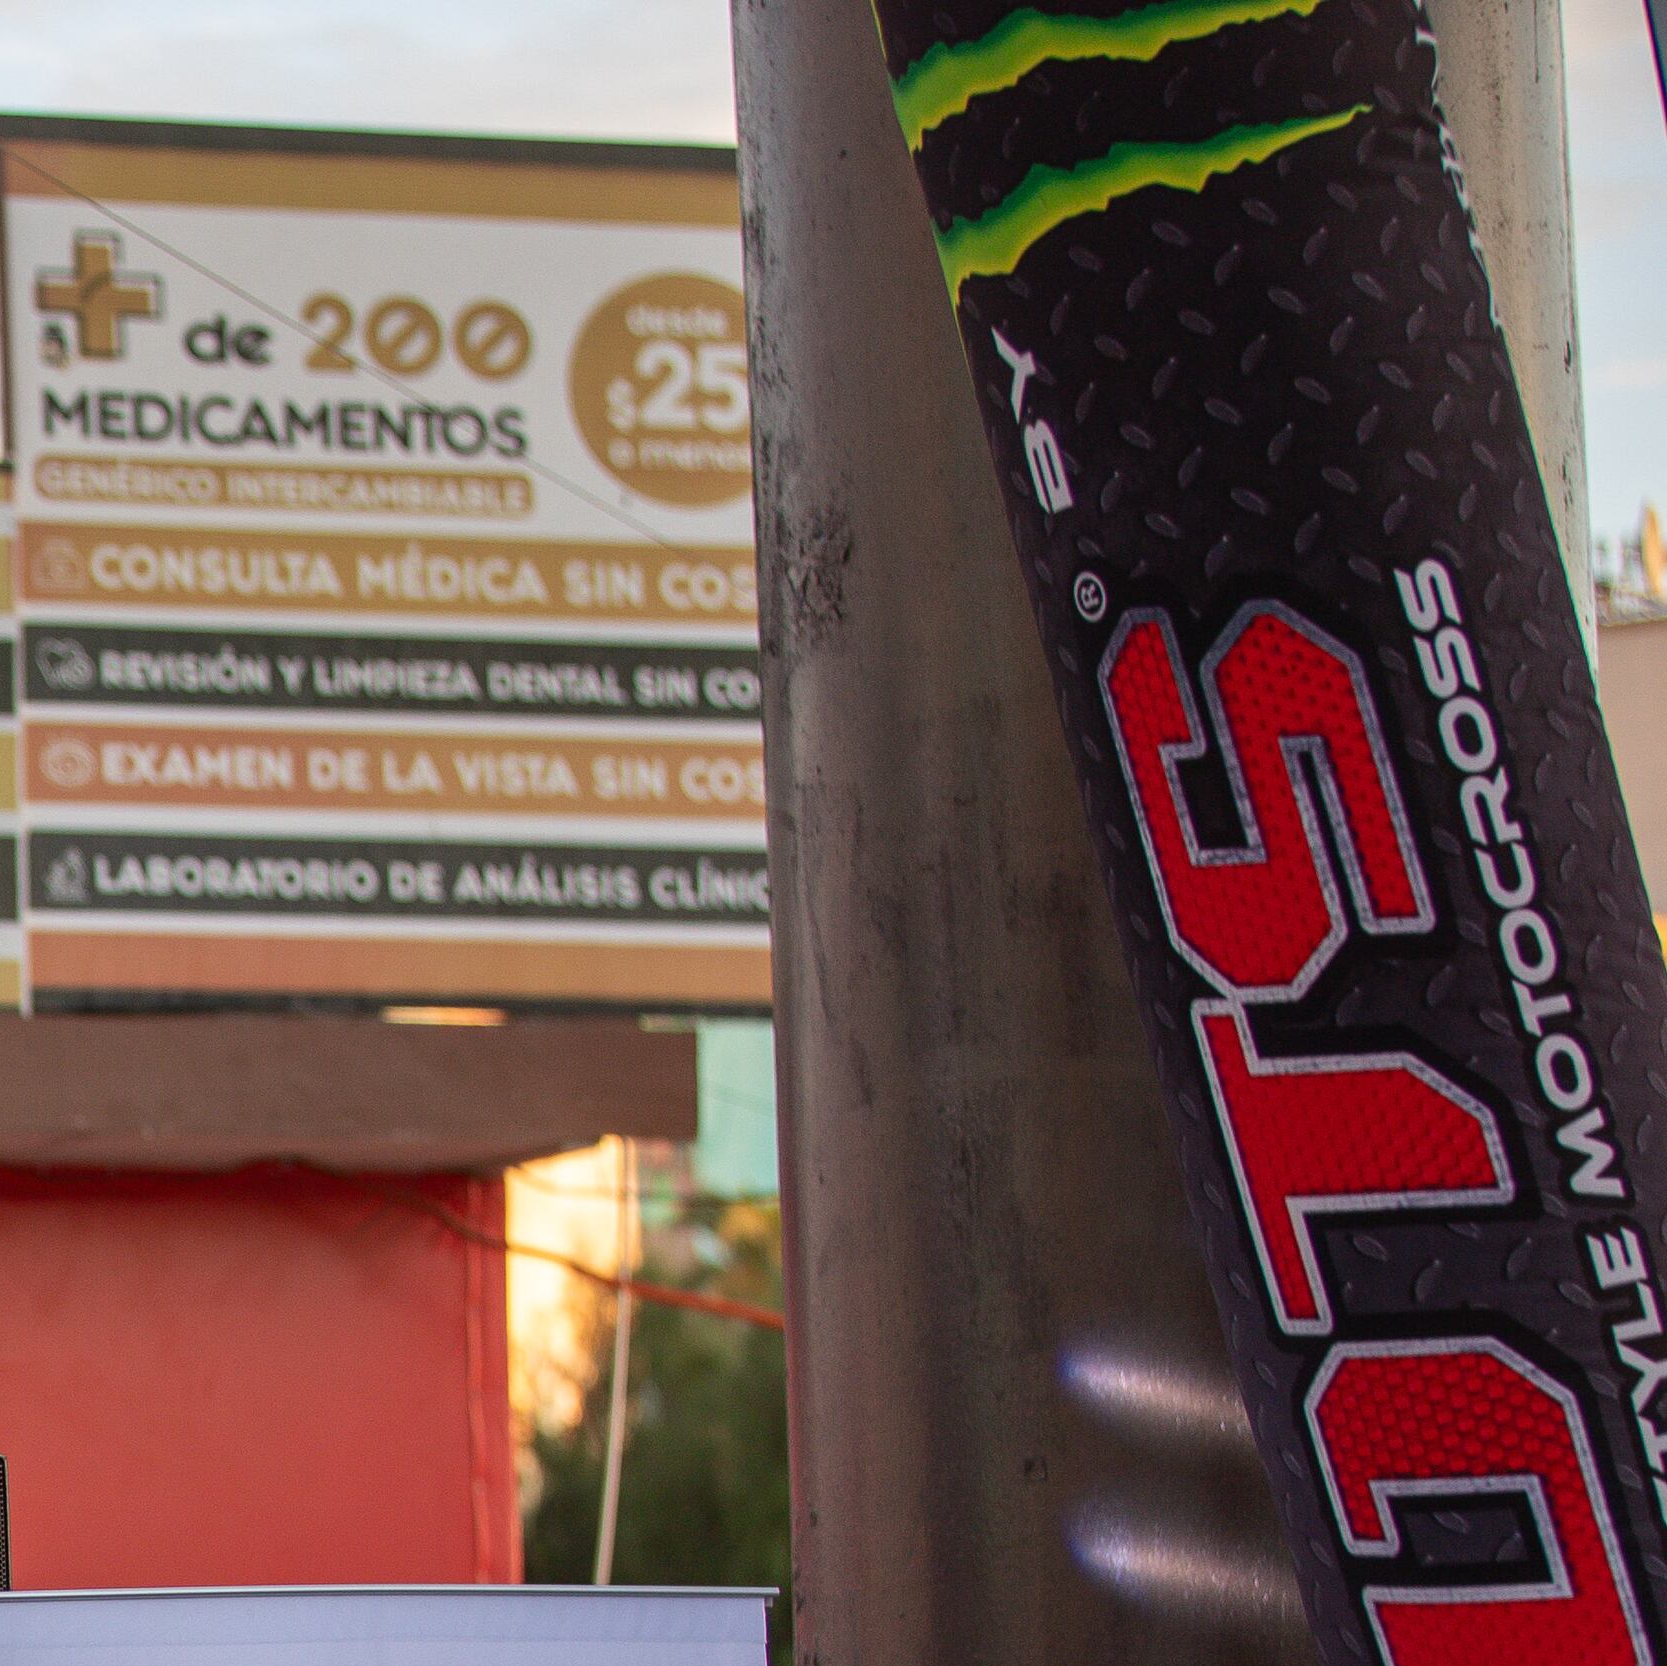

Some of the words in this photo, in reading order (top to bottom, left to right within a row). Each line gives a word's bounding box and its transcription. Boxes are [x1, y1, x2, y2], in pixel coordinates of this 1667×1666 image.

[184, 315, 275, 367] de
[41, 389, 528, 457] MEDICAMENTOS
[991, 327, 1073, 514] BY
[89, 544, 342, 598] CONSULTA
[358, 542, 548, 601] MÉDICA
[562, 560, 644, 606] SIN
[658, 561, 758, 611] COS
[98, 643, 268, 694] REVISIÓN
[276, 657, 309, 694] Y
[314, 658, 481, 701] LIMPIEZA
[488, 661, 626, 706] DENTAL
[633, 667, 695, 706] SIN
[100, 741, 291, 790] EXAMEN
[308, 748, 367, 793] DE
[382, 751, 444, 796] LA
[453, 754, 579, 798] VISTA
[591, 759, 665, 800] SIN
[679, 761, 766, 804] COS
[94, 855, 379, 901] LABORATORIO
[388, 862, 441, 903] DE
[453, 855, 639, 908] ANÁLISIS
[649, 857, 772, 913] CLÍNIC
[1394, 558, 1625, 1200] MOTOCROSS
